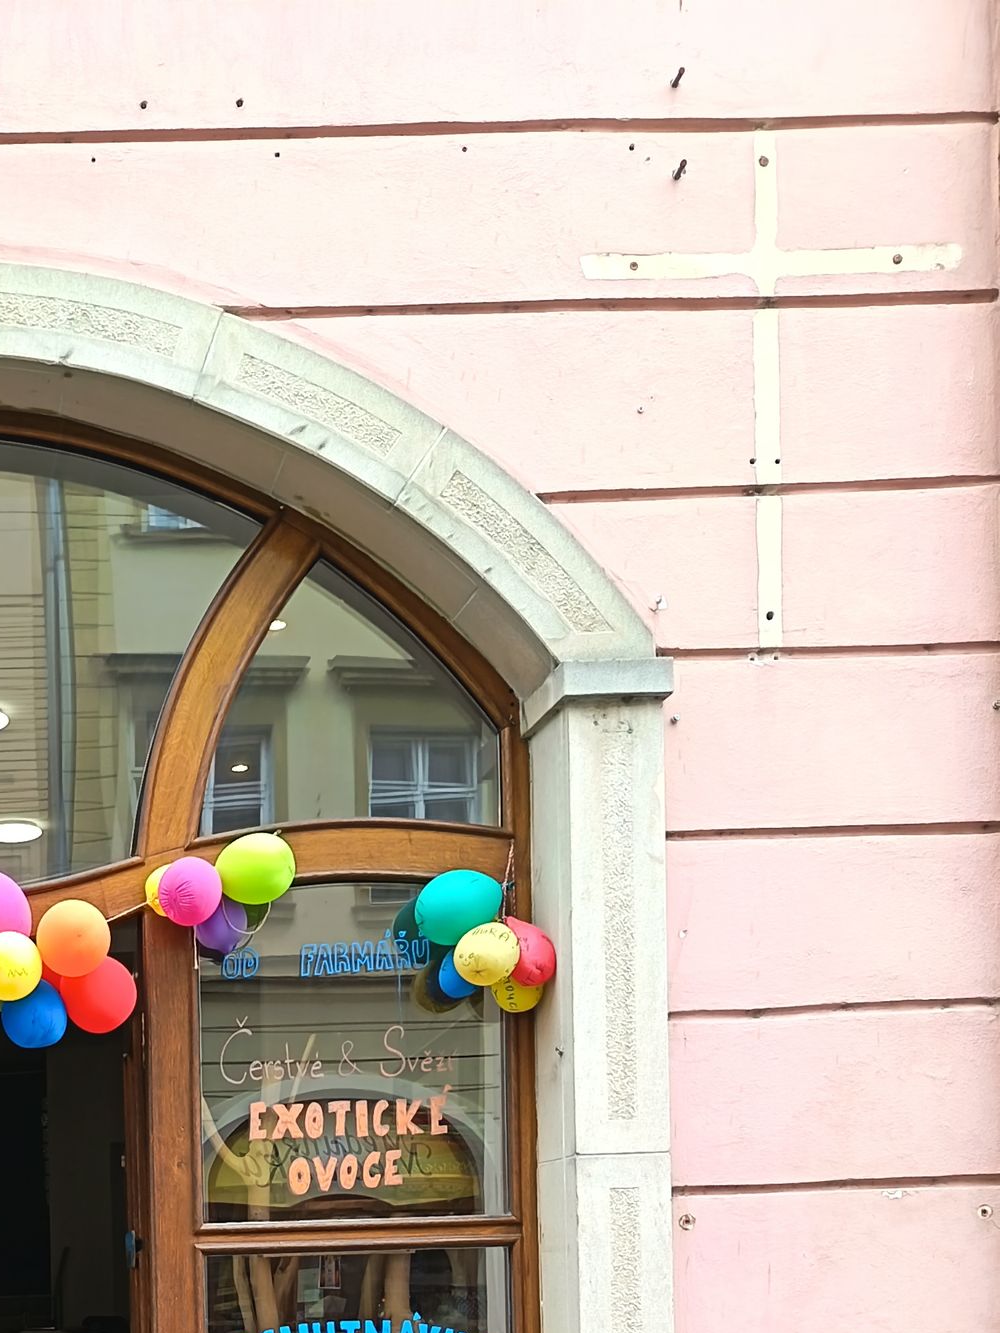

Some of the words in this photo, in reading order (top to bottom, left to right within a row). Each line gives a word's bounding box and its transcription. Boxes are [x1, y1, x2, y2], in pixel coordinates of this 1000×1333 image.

[221, 947, 259, 979] OD
[338, 1040, 364, 1077] &
[249, 1084, 453, 1140] EXOTICKÉ
[289, 1150, 403, 1195] OVOCE
